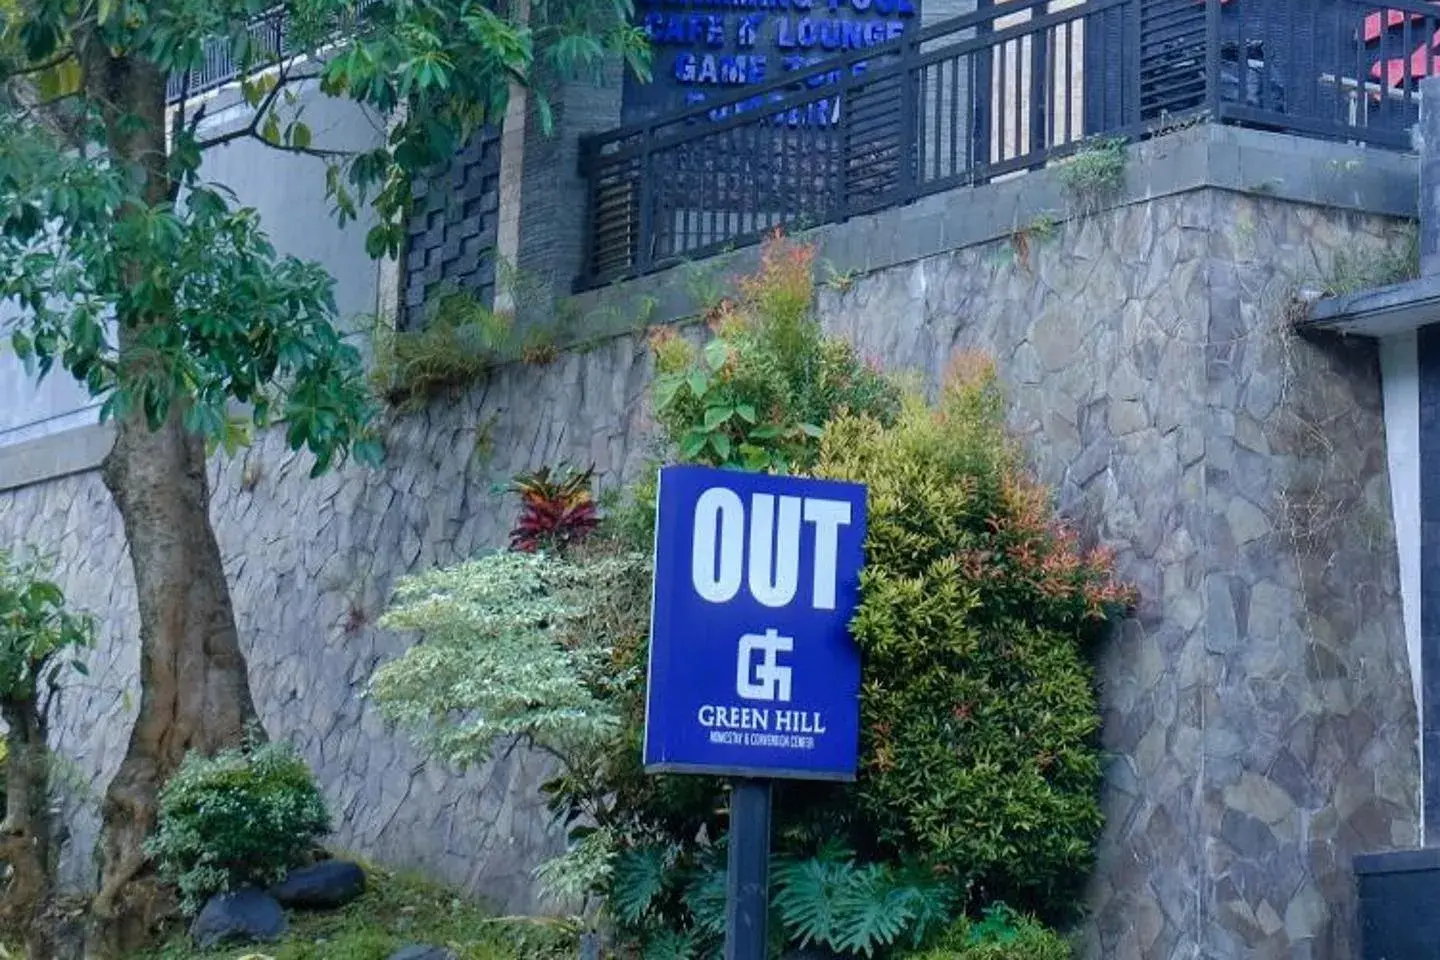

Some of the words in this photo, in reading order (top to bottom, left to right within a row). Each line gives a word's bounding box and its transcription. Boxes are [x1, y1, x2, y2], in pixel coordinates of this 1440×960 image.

[777, 15, 904, 48] LOUNGE
[675, 52, 767, 83] GAME
[692, 487, 851, 610] OUT
[698, 705, 769, 730] GREEN
[775, 710, 826, 734] HILL
